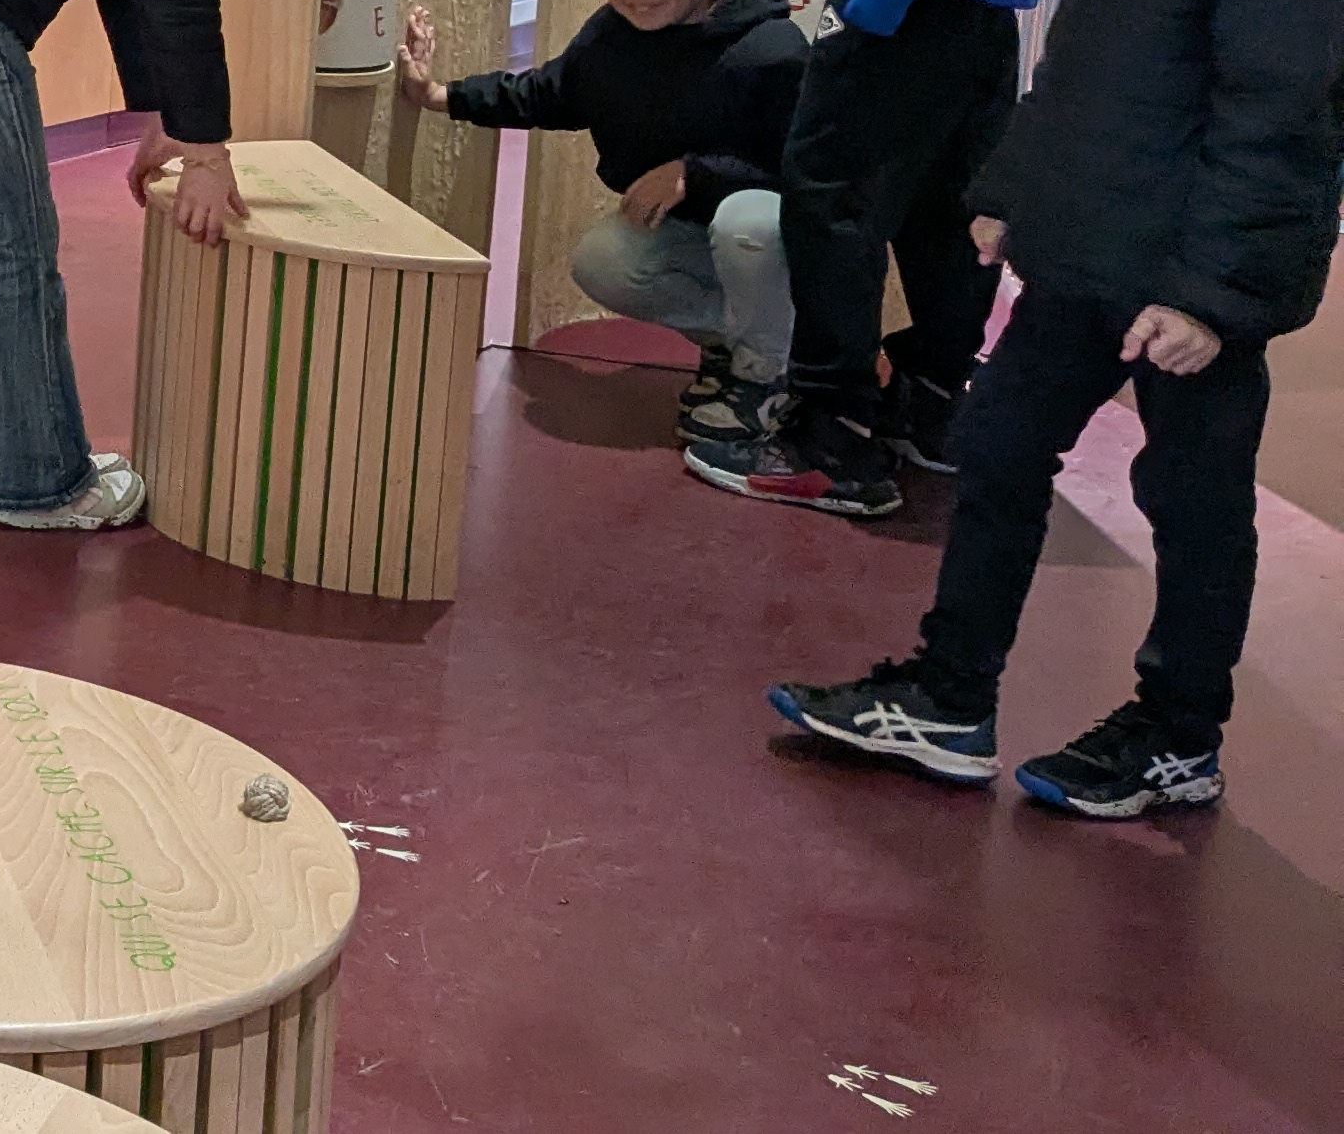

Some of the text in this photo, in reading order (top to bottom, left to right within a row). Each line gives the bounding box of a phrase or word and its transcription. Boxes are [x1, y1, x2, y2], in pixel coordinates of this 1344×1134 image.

[15, 731, 64, 755] LE
[35, 764, 85, 795] SUR
[55, 805, 133, 884] CACHE
[99, 896, 152, 921] SE
[121, 933, 177, 972] QUI
